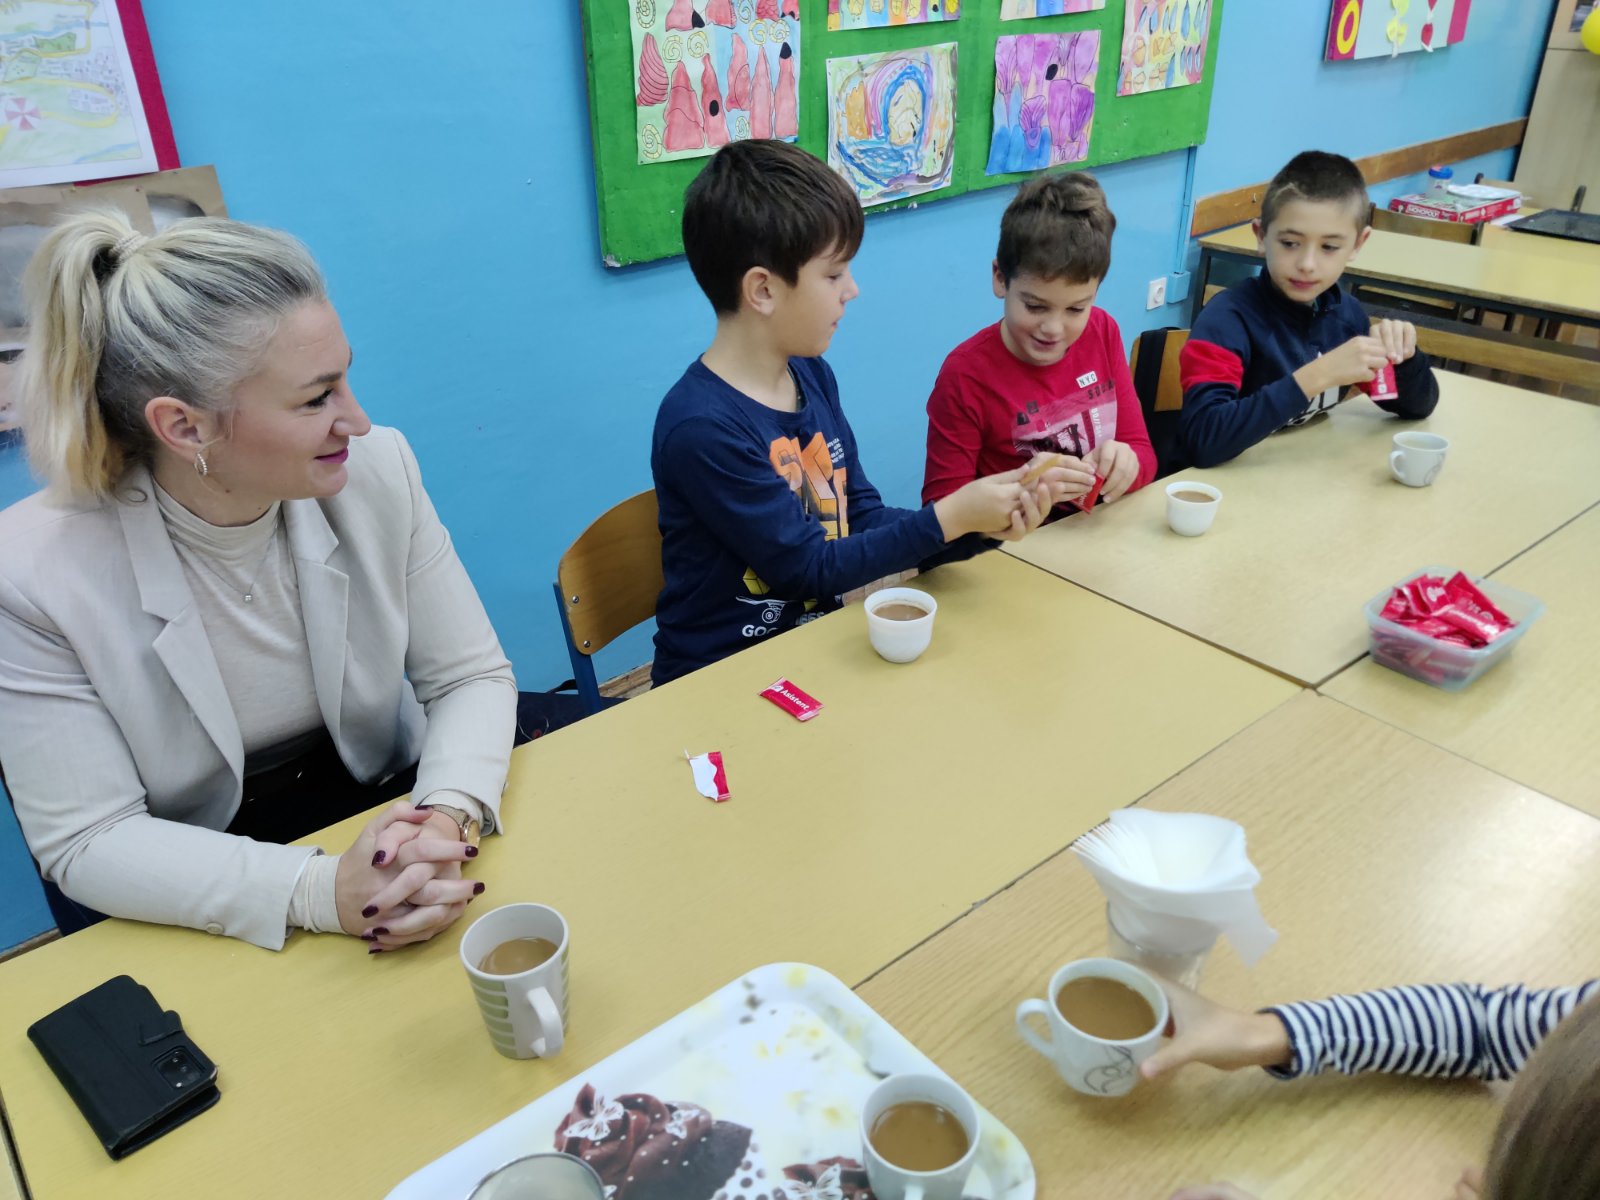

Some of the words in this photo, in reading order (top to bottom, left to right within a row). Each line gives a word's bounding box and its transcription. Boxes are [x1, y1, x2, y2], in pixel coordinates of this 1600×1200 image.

[1407, 203, 1439, 219] MONOPOLY
[1079, 373, 1097, 387] NYC
[780, 689, 810, 710] Asistent
